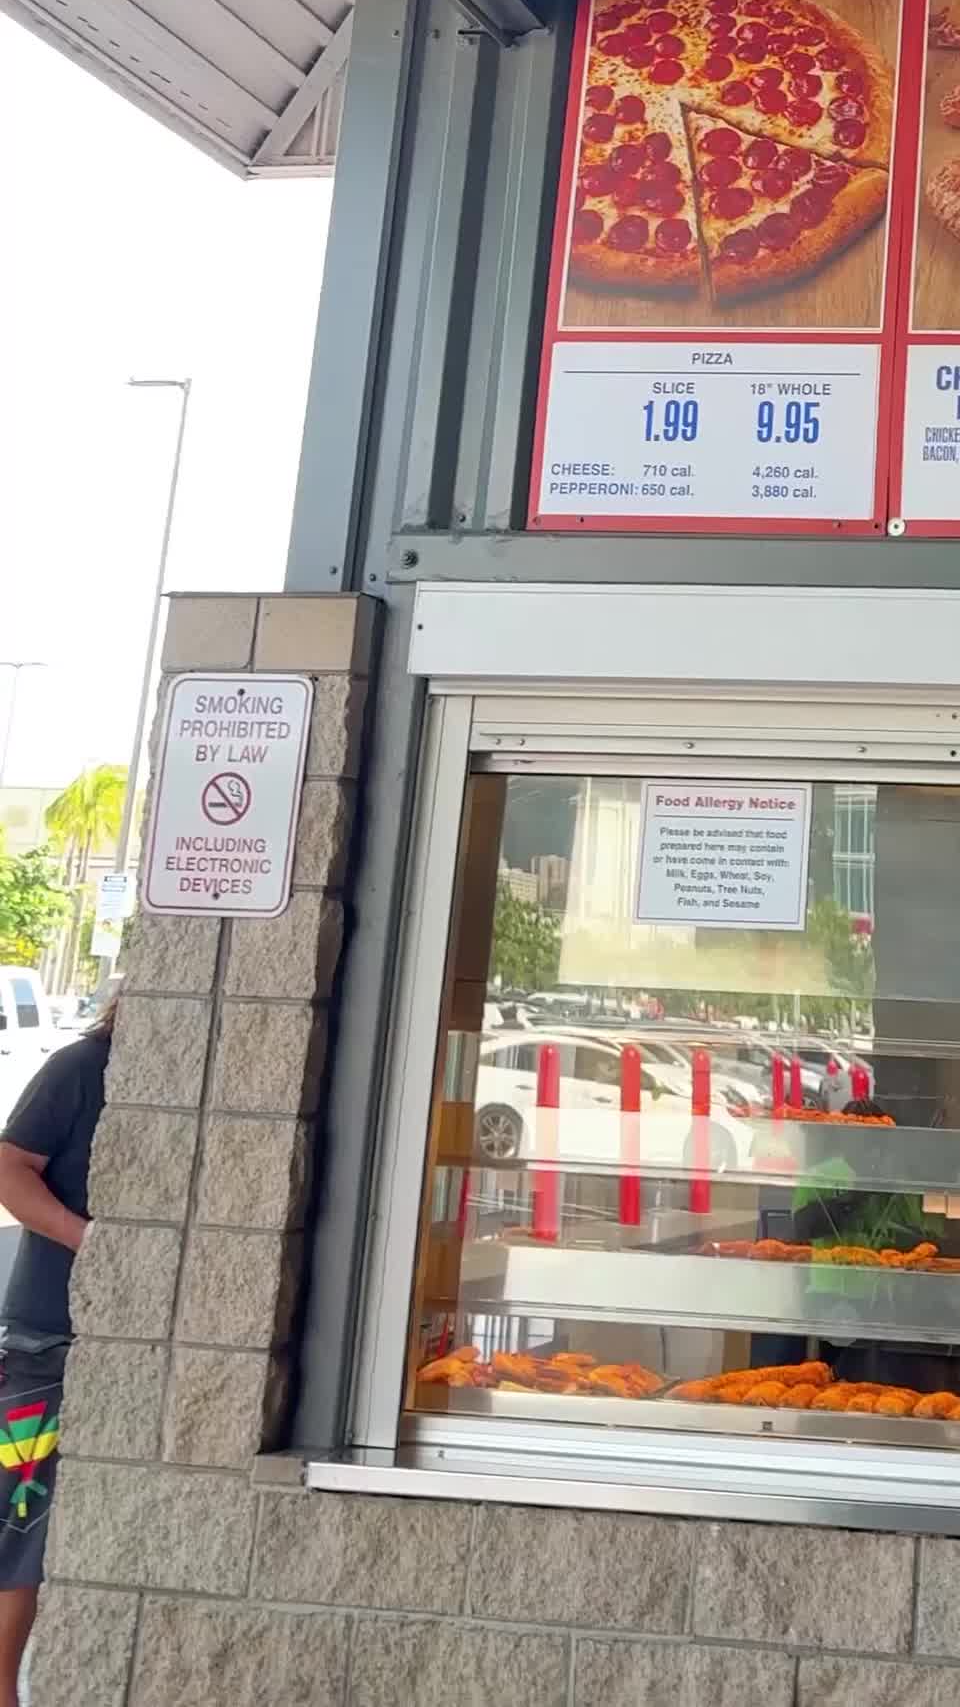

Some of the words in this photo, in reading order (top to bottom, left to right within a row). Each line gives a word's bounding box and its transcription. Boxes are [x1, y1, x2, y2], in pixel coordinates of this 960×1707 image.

[692, 353, 733, 365] PIZZA
[653, 382, 695, 394] SLICE
[777, 384, 832, 396] WHOLE
[643, 400, 698, 442] 1.99
[757, 401, 820, 443] 9.95
[551, 464, 615, 477] CHEESE:
[643, 464, 667, 477] 710
[671, 465, 695, 478] cal.
[752, 466, 789, 479] 4,260
[793, 466, 819, 479] cal.
[550, 483, 639, 496] PEPPERONI:
[641, 484, 665, 496] 650
[670, 484, 694, 496] cal.
[751, 485, 788, 499] 3,880
[792, 486, 817, 499] cal.
[195, 695, 283, 714] SMOKING
[179, 720, 291, 739] PROHIBITED
[195, 745, 220, 762] BY
[227, 745, 268, 763] LAW
[656, 795, 690, 807] Food
[695, 796, 744, 811] Allergy
[749, 797, 796, 810] Notice
[660, 827, 690, 837] Please
[693, 828, 704, 837] be
[707, 828, 744, 838] advised
[745, 829, 763, 839] that
[766, 829, 787, 839] food
[175, 837, 266, 853] INCLUDING
[660, 842, 702, 853] prepared
[705, 842, 724, 852] here
[728, 844, 746, 854] may
[750, 843, 784, 853] contain
[165, 857, 272, 874] ELECTRONIC
[666, 855, 688, 865] have
[689, 856, 715, 866] come
[718, 856, 727, 866] in
[729, 857, 765, 867] contact
[179, 877, 252, 894] DEVICES
[717, 884, 738, 894] Tree
[702, 898, 720, 908] and
[722, 899, 760, 909] Sesame
